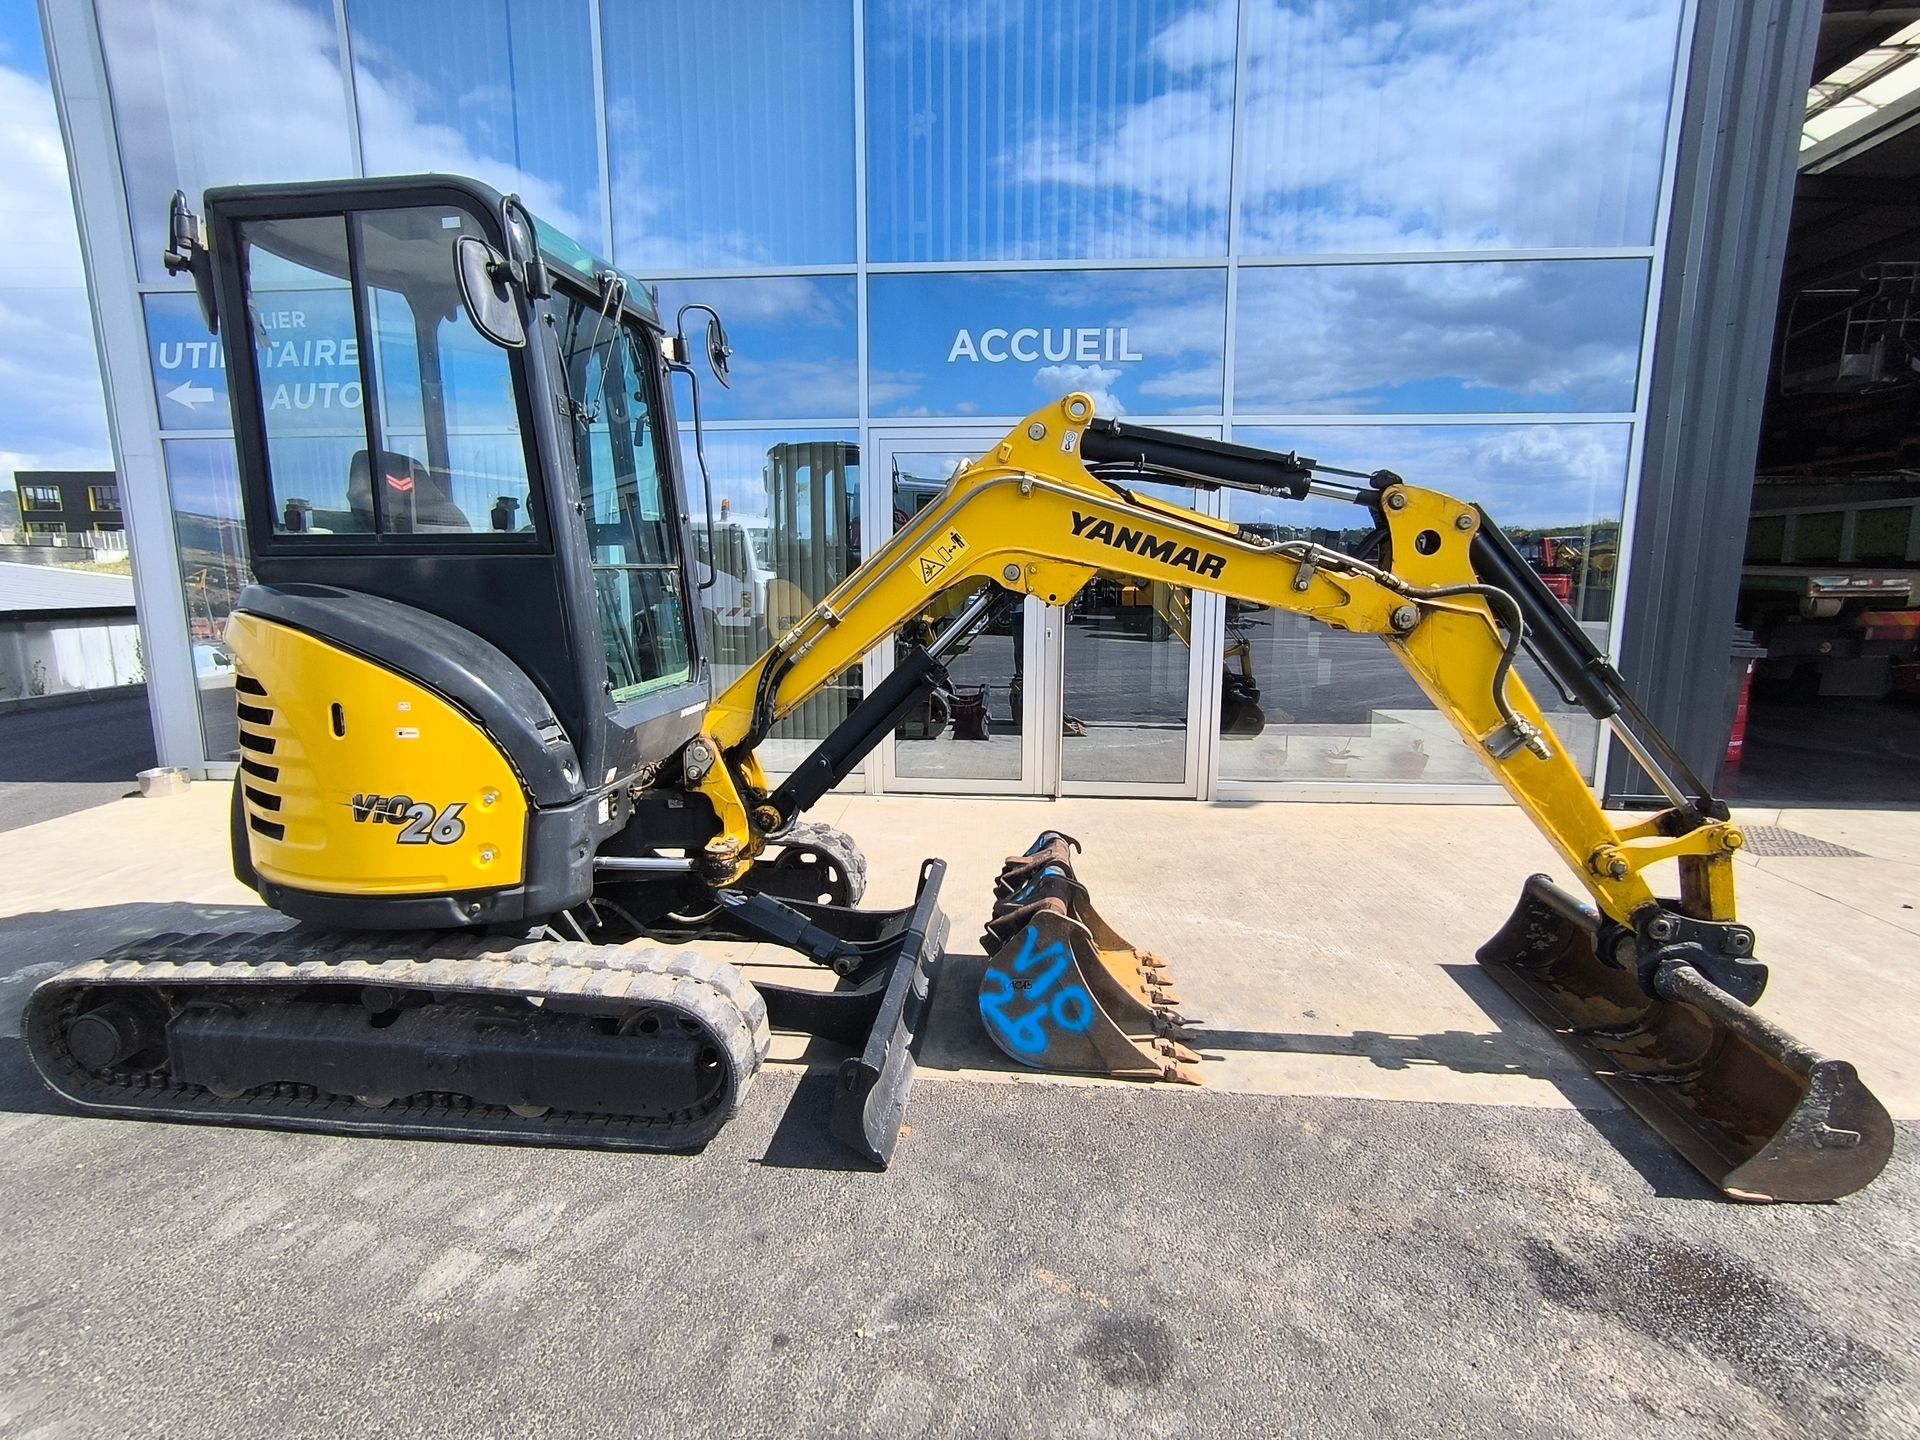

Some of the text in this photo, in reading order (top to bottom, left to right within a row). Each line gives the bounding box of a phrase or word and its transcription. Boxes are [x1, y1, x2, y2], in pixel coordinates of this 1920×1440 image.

[260, 310, 307, 329] LIER
[947, 327, 1143, 363] ACCUEIL
[1071, 510, 1227, 580] YANMAR
